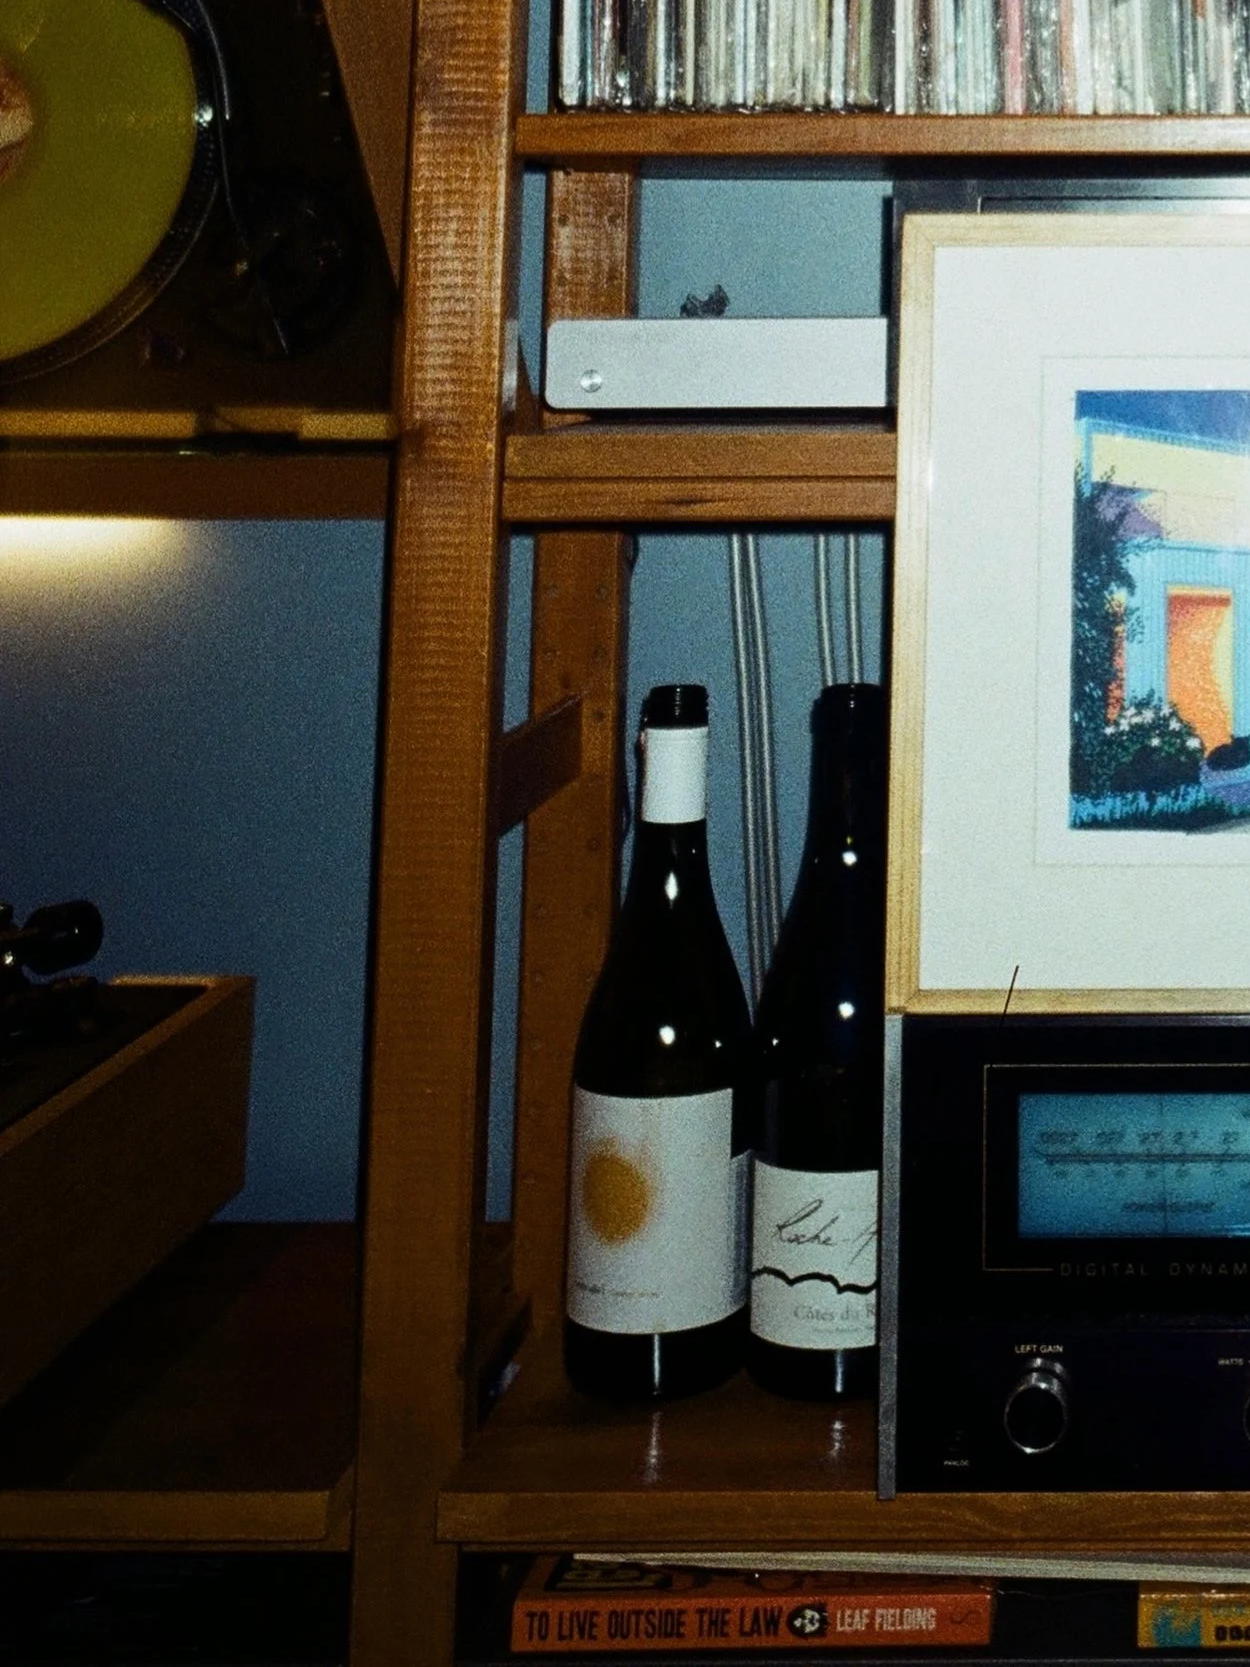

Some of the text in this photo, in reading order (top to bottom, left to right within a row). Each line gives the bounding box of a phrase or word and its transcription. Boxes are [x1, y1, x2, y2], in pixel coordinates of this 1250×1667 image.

[1060, 1263, 1149, 1277] DIGITAL
[1014, 1344, 1064, 1354] LEFT GAIN
[525, 1607, 783, 1641] TO LIVE OUTSIDE THE LAW
[836, 1607, 938, 1631] LEAF FIELDING
